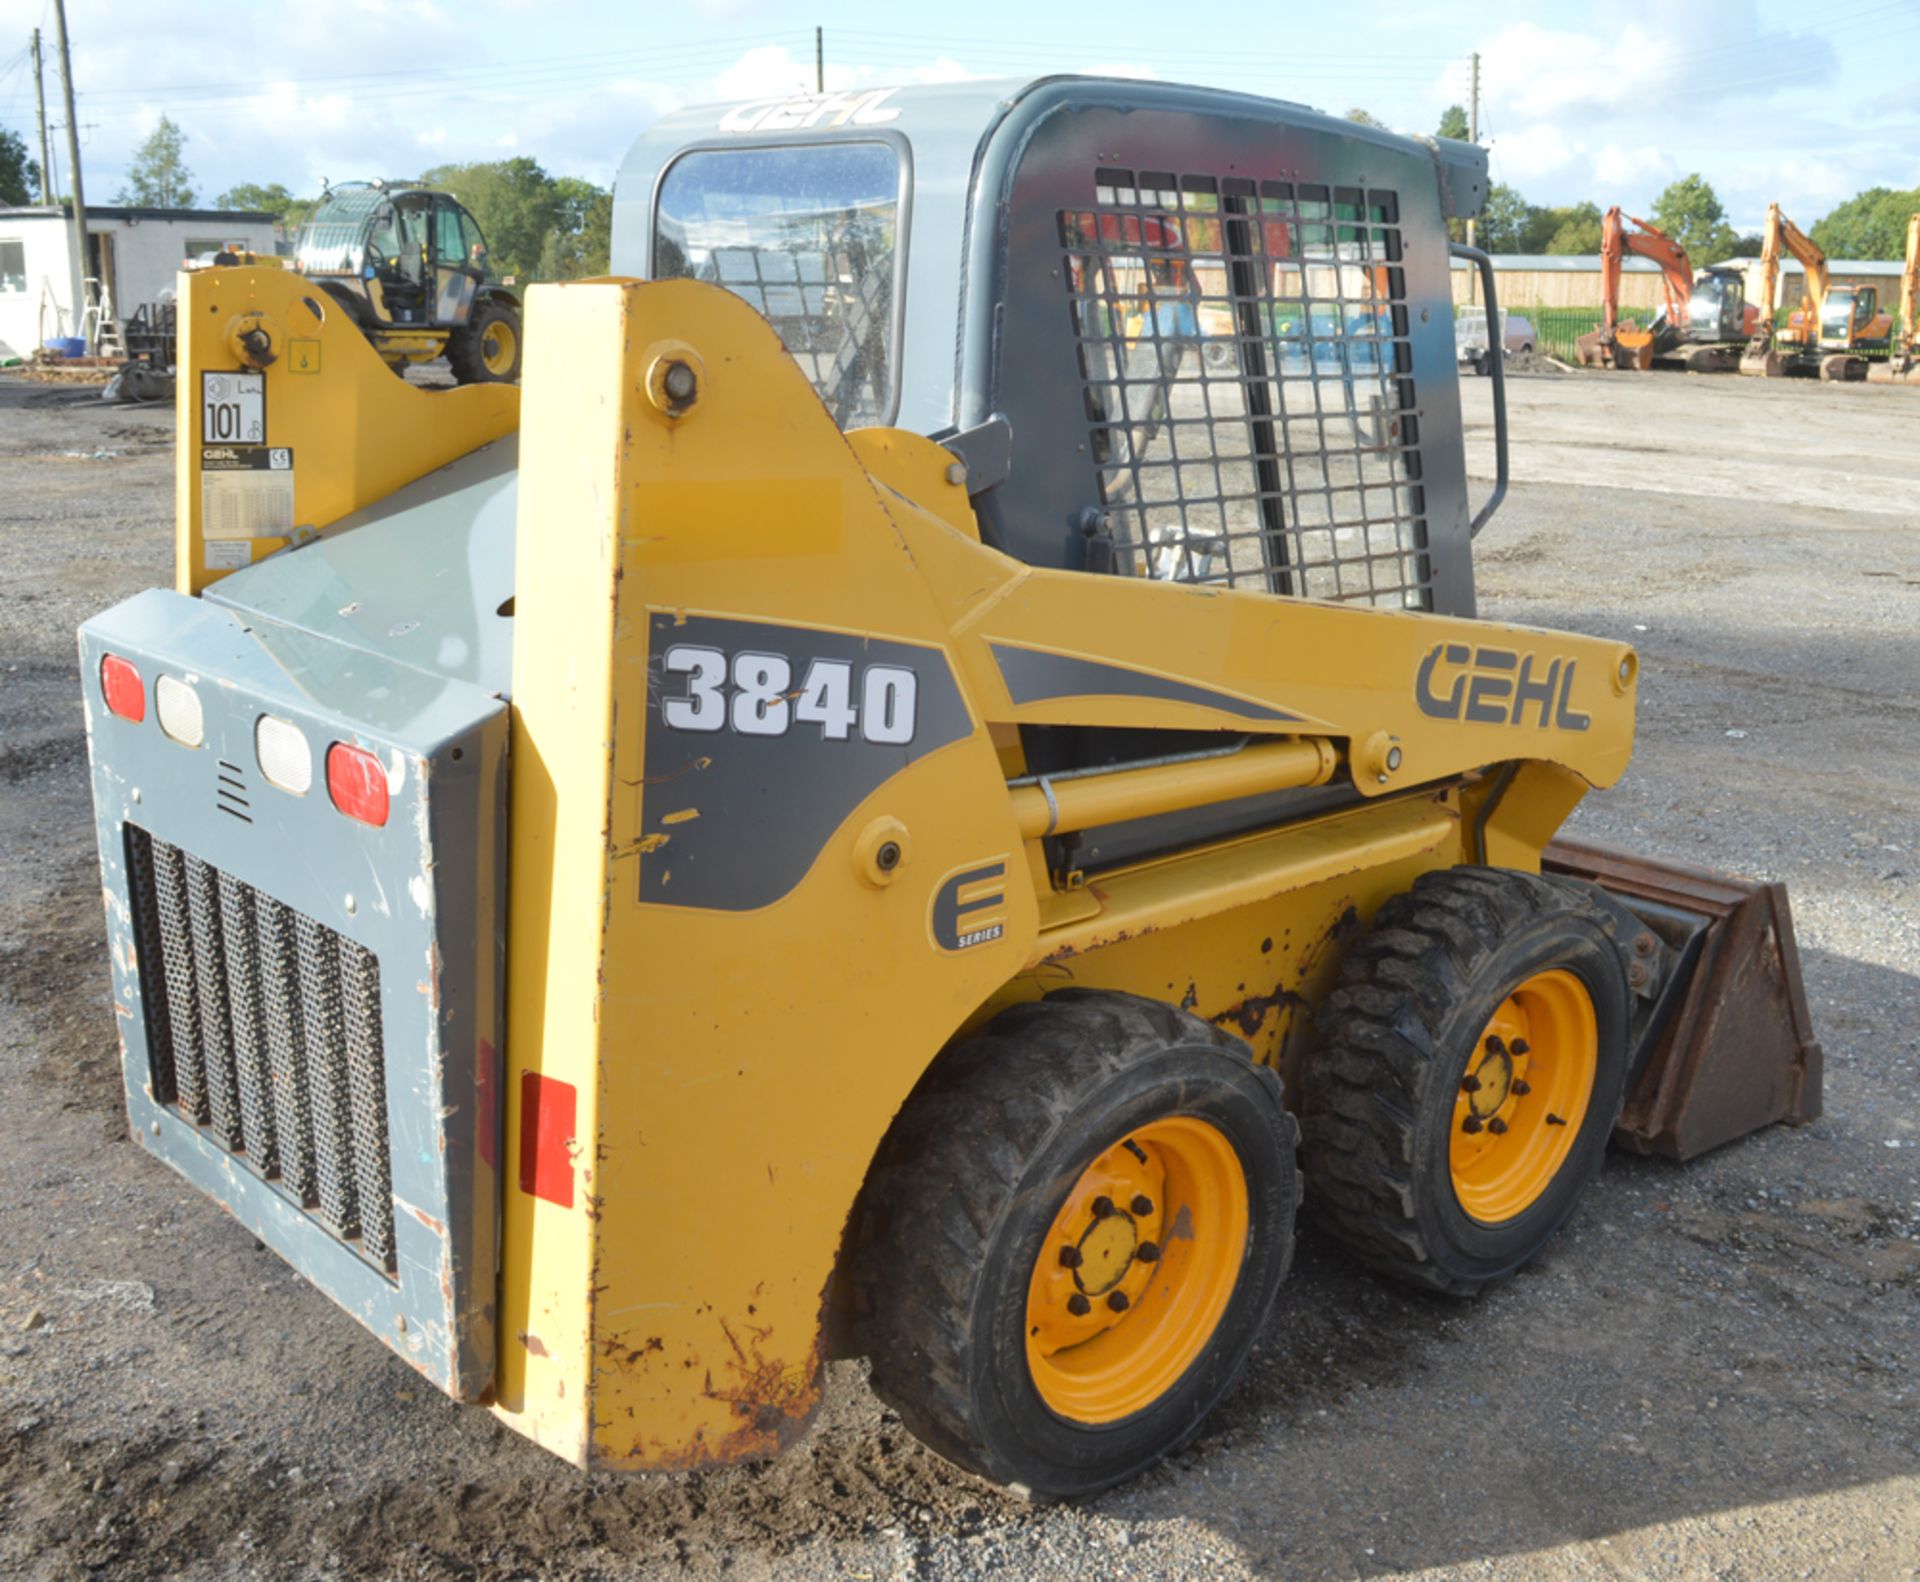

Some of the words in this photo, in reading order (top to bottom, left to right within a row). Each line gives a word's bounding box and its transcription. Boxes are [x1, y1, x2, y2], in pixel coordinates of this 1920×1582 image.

[719, 87, 902, 132] GEHL
[207, 403, 241, 440] 101
[663, 644, 917, 745] 3840
[1415, 643, 1591, 731] GEHL
[931, 858, 1006, 951] E
[958, 925, 1001, 948] SERIES
